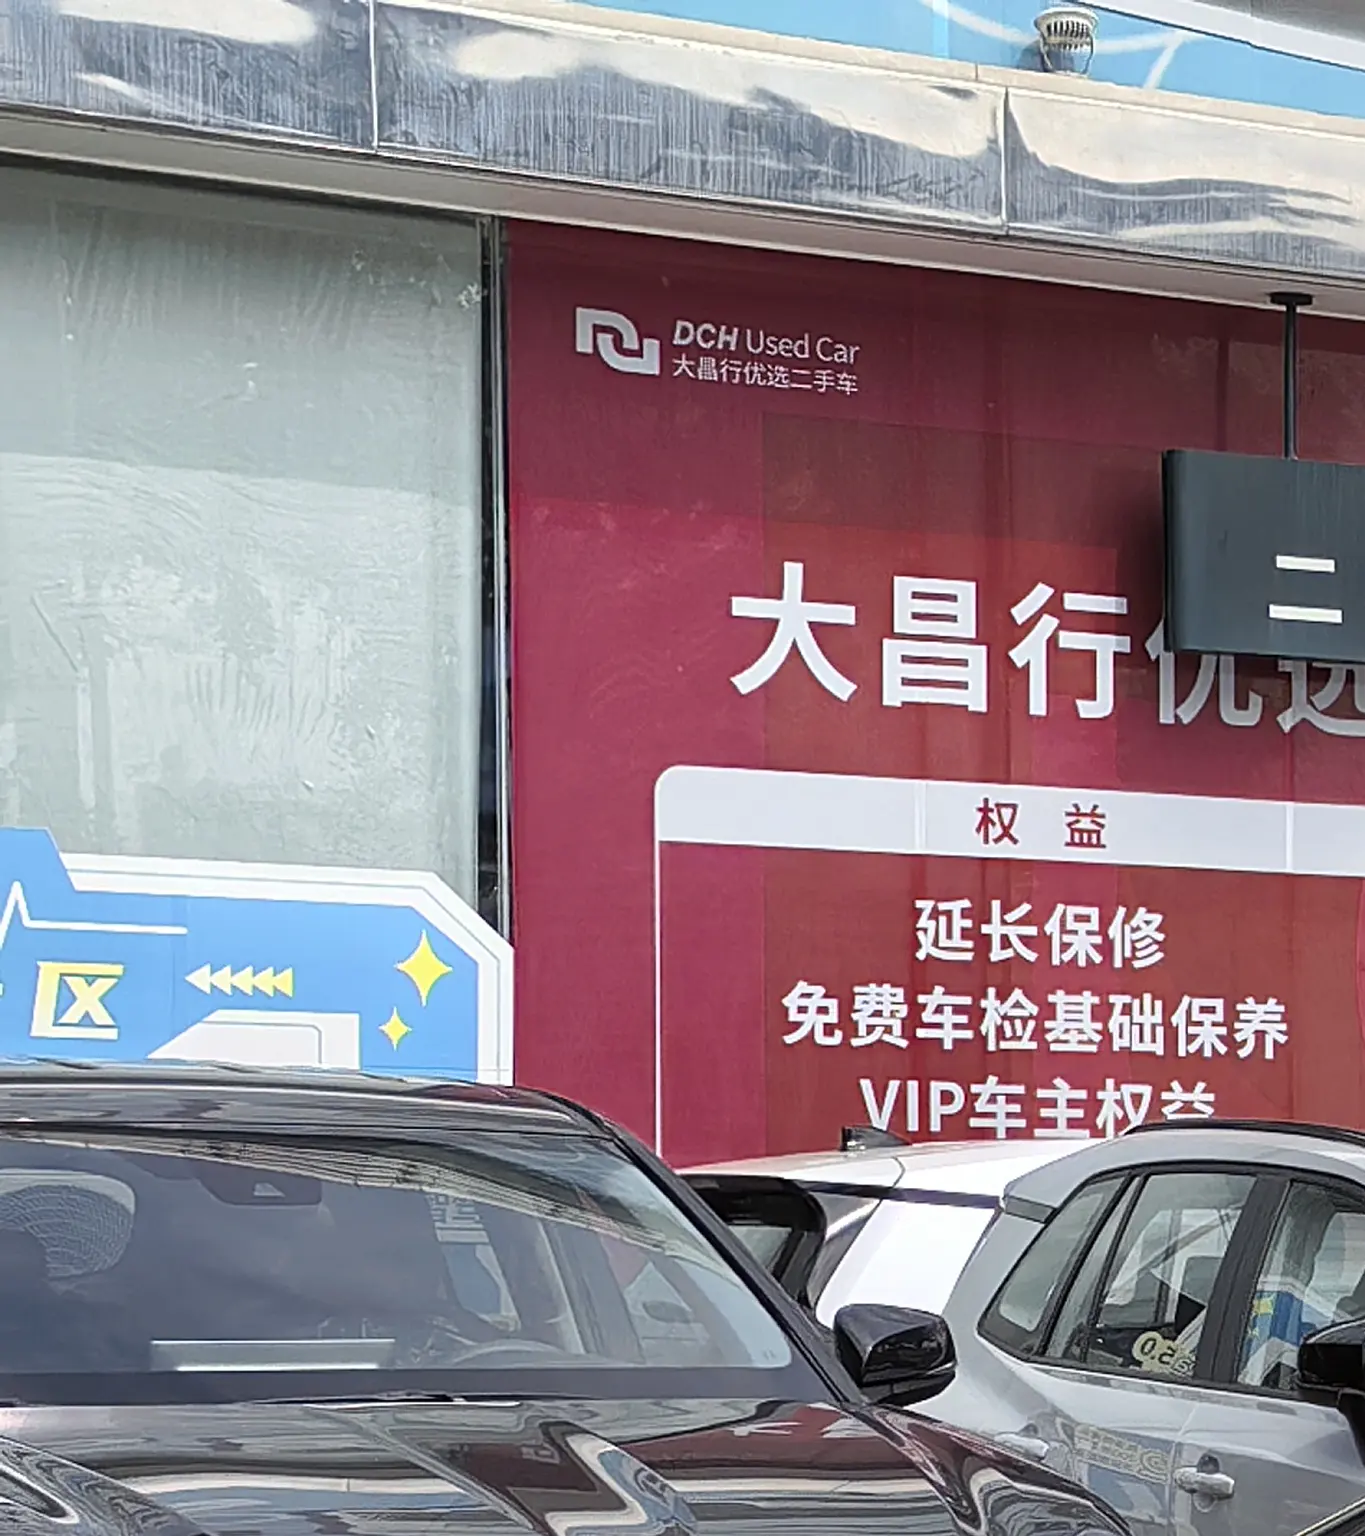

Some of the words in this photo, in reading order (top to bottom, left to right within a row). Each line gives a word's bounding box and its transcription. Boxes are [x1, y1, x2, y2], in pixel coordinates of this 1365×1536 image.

[672, 353, 859, 396] 大昌行优选二手车
[673, 320, 739, 352] DCH
[747, 329, 809, 360] Used
[816, 337, 859, 365] Car
[915, 898, 1166, 970] 延长保修
[782, 979, 1289, 1061] 免费车检基础保养
[859, 1075, 1216, 1139] VIP车主权益
